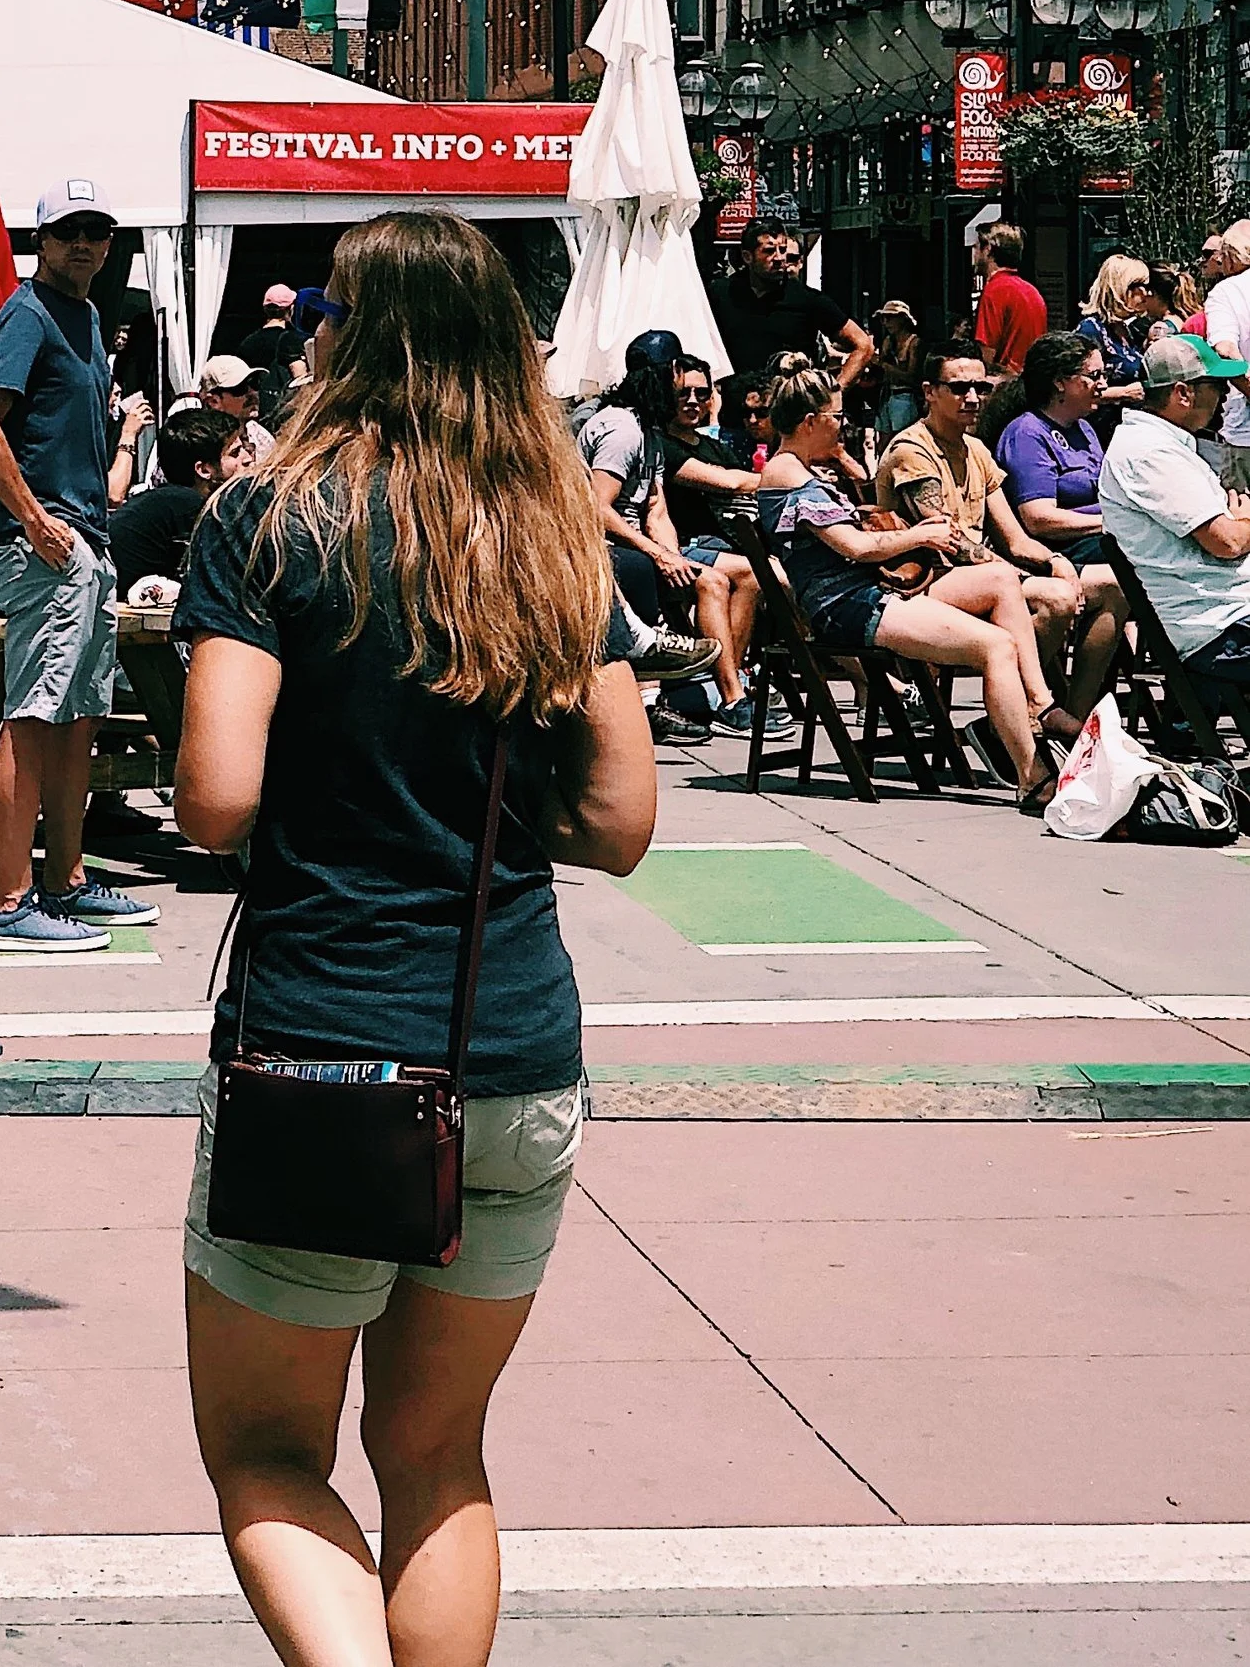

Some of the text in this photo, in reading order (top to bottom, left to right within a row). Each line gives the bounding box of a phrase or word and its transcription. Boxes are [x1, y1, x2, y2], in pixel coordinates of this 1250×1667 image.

[204, 131, 383, 160] FESTIVAL
[392, 134, 483, 161] INFO
[960, 151, 984, 162] FOR
